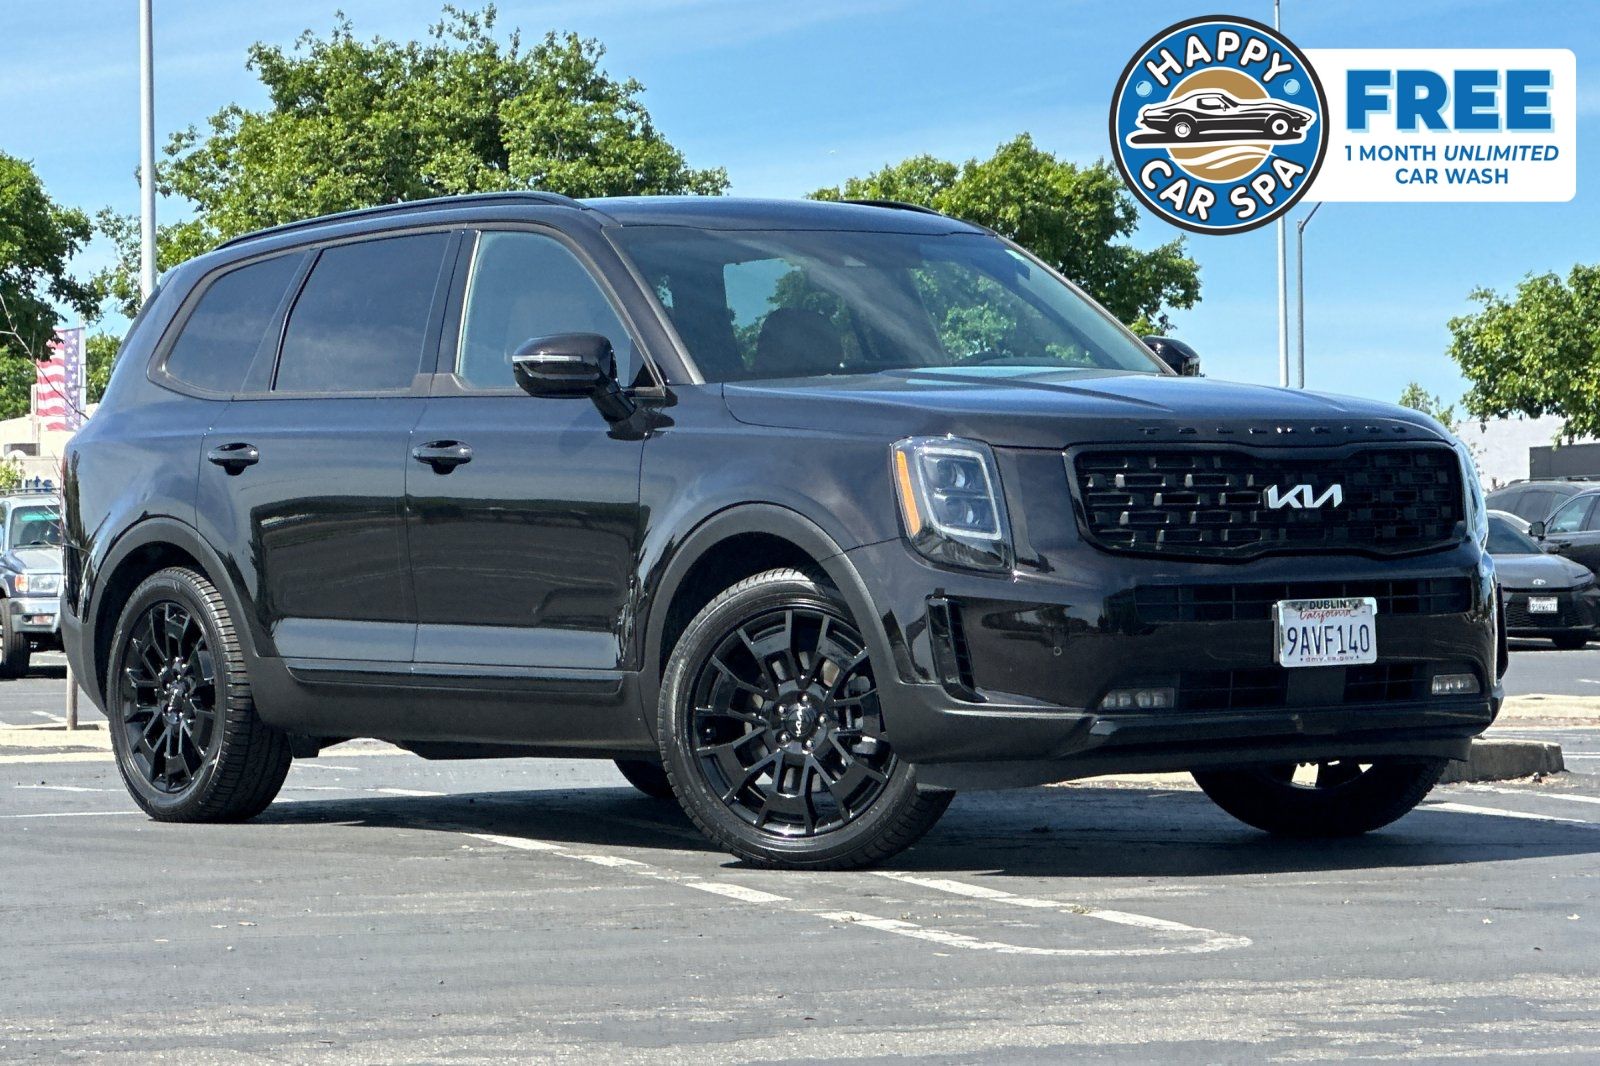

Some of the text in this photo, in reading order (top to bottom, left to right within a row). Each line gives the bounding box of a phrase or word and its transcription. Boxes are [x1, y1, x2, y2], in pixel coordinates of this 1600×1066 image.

[1266, 484, 1344, 509] KIA
[1309, 599, 1347, 610] DUBLIN
[1287, 624, 1370, 656] 9AVF140
